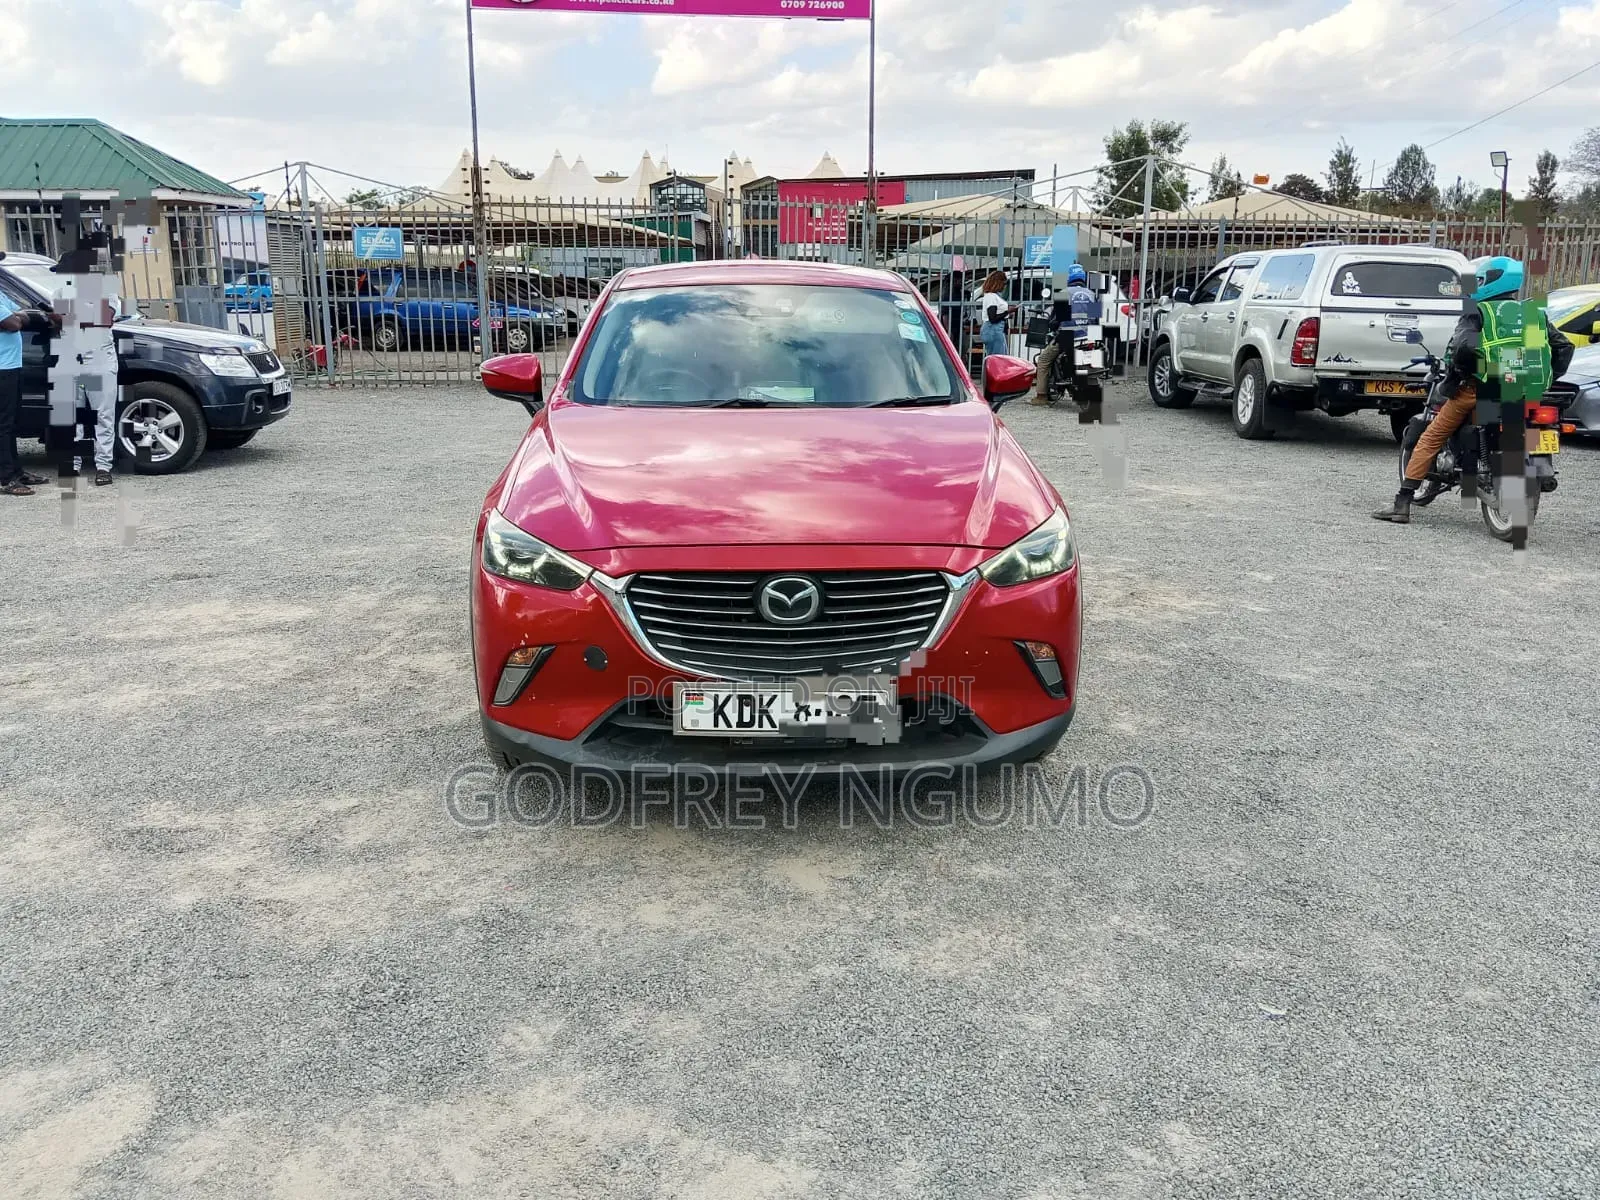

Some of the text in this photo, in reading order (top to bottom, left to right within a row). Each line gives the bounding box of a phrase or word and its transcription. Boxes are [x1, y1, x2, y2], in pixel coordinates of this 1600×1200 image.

[807, 1, 845, 9] 726900
[1375, 381, 1395, 393] KCS
[713, 693, 779, 729] KDK
